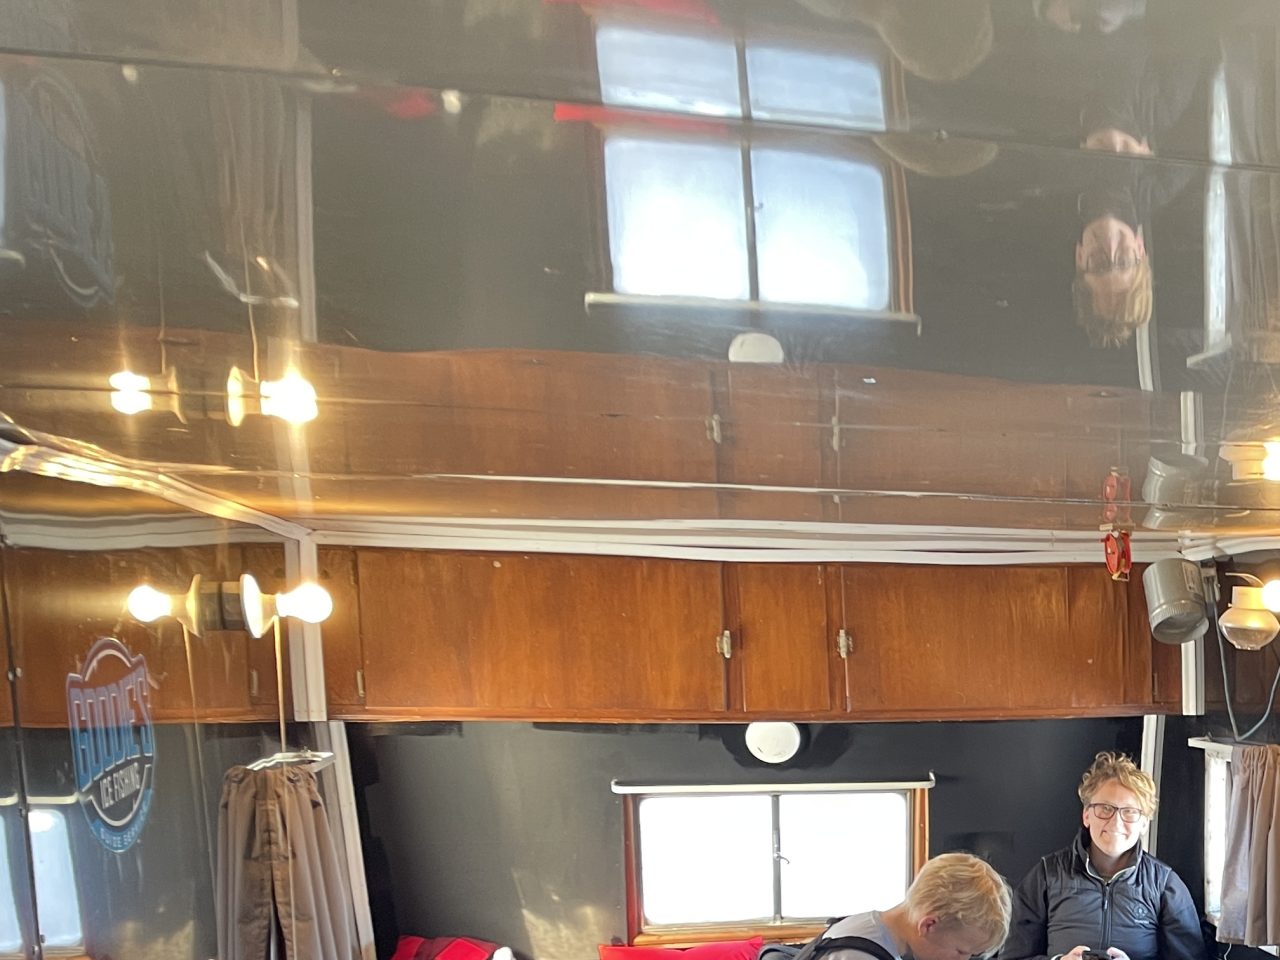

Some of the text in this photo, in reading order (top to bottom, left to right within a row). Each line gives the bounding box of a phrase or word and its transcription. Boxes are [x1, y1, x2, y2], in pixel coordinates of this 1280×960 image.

[69, 666, 153, 792] GOODIE'S
[99, 762, 141, 809] ICE FISHING
